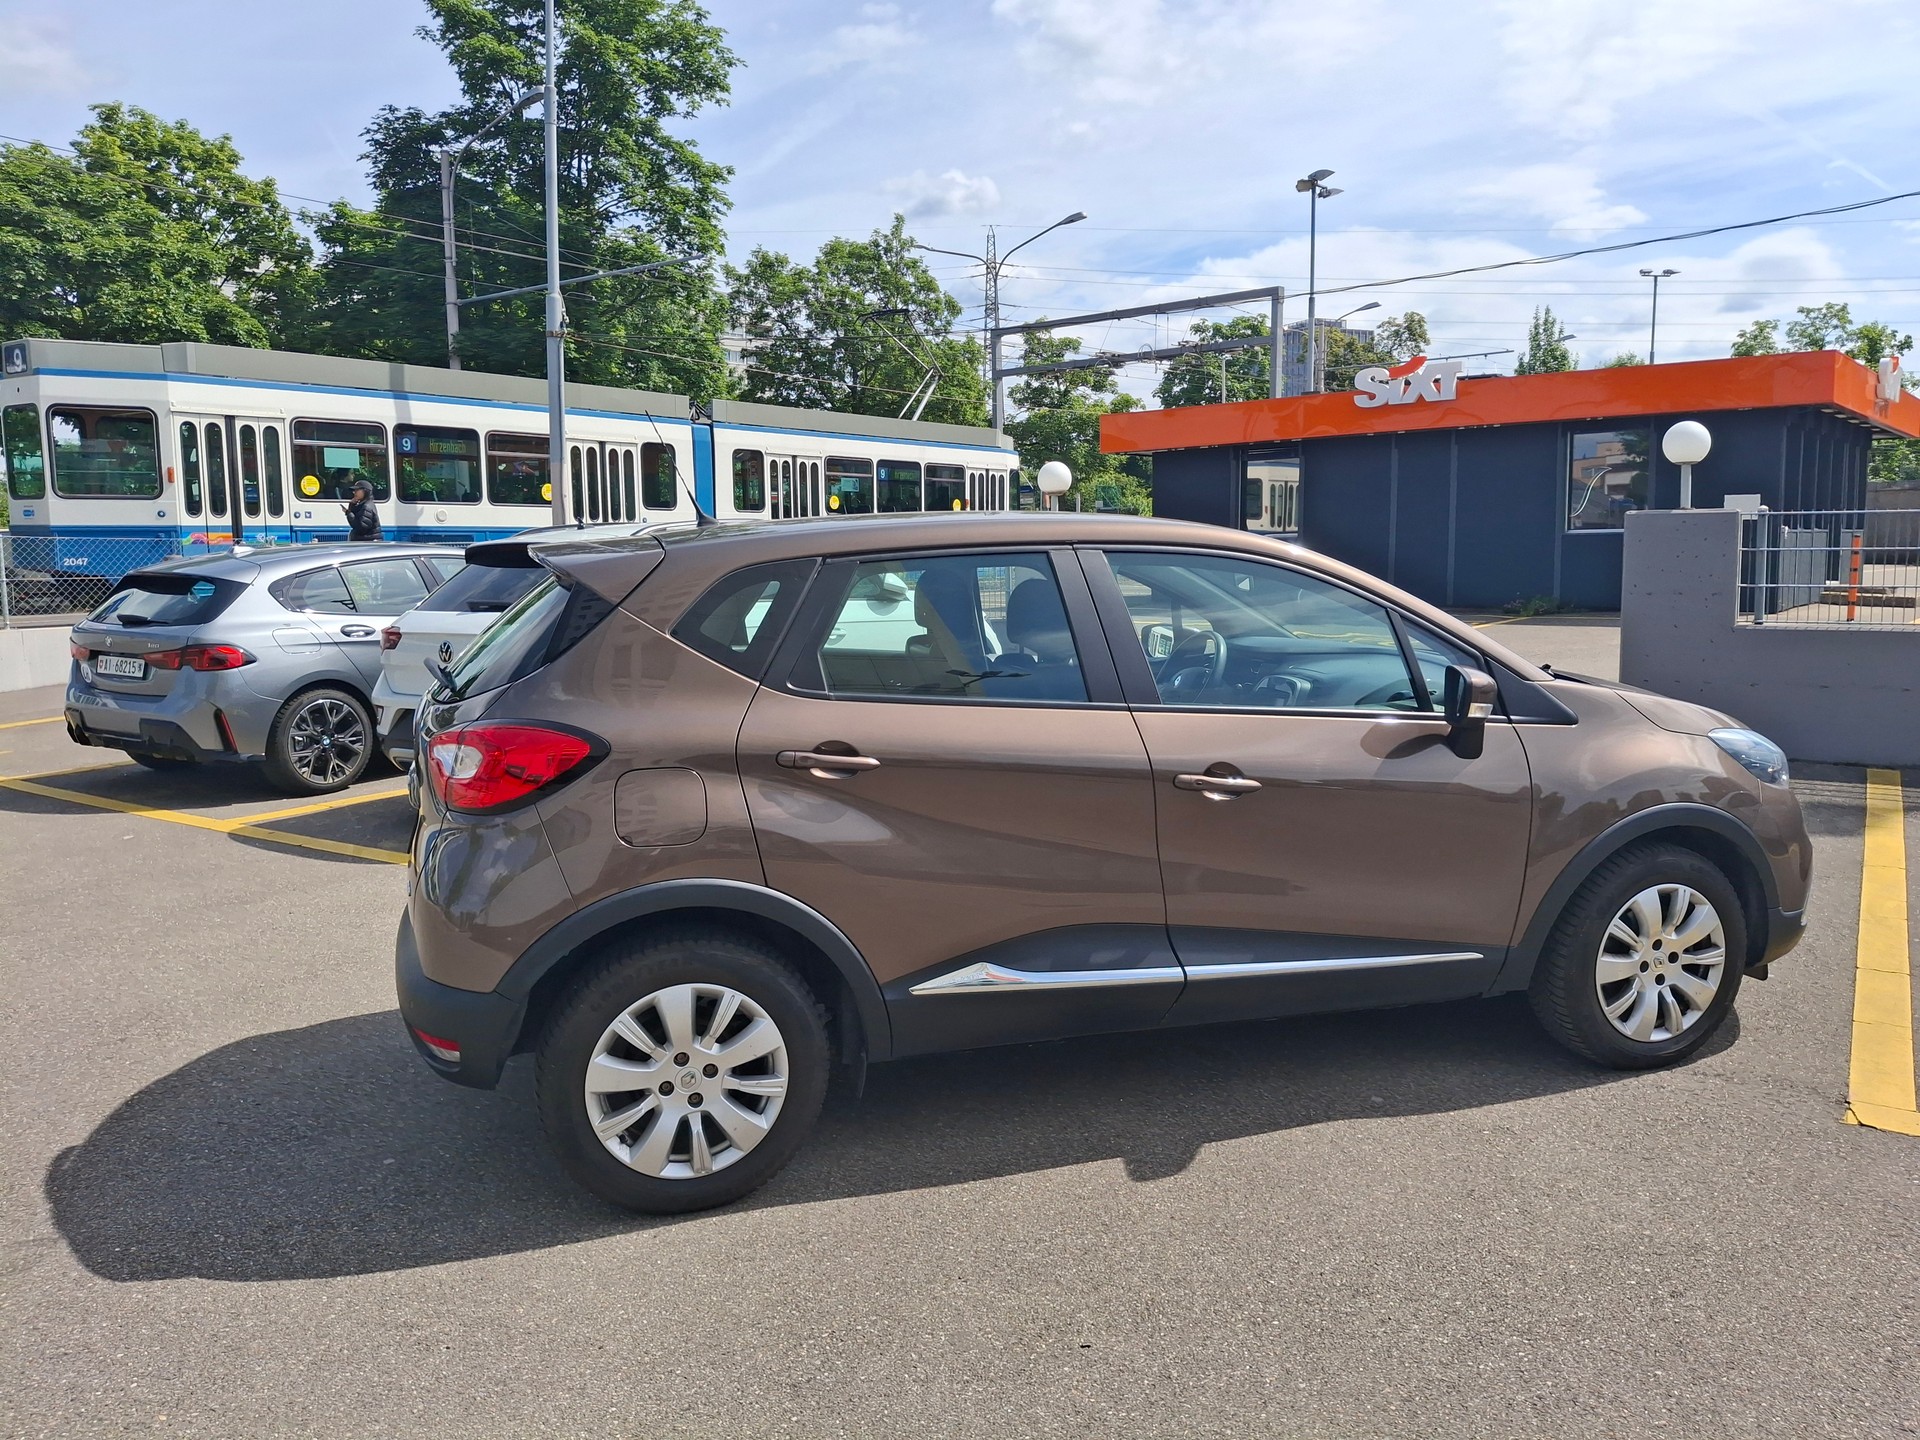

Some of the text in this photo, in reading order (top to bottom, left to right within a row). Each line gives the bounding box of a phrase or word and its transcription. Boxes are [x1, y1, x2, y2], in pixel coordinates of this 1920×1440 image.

[14, 348, 22, 372] 9
[402, 437, 411, 451] 9
[880, 468, 886, 479] 9
[63, 557, 88, 566] 2047
[114, 659, 137, 674] 68215
